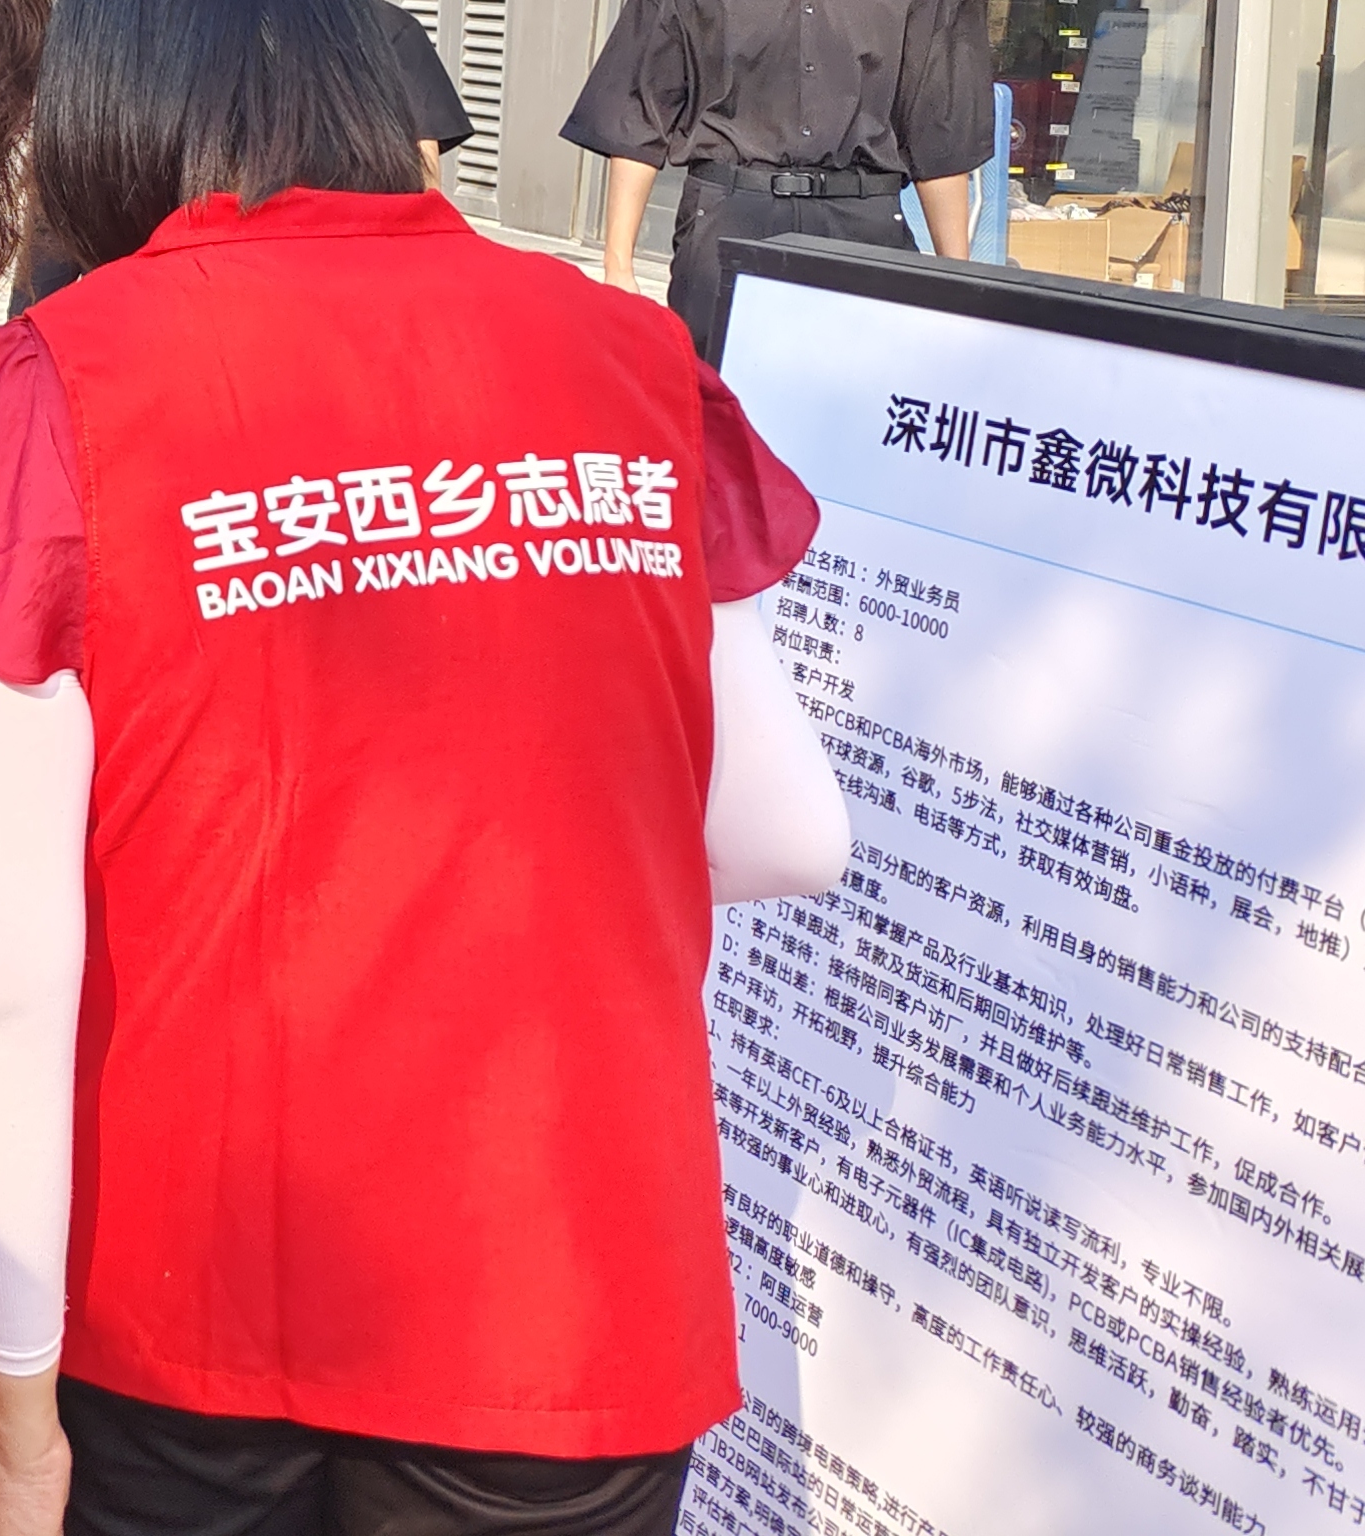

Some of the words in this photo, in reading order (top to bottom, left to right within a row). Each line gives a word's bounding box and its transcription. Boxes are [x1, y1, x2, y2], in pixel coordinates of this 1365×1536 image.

[181, 452, 679, 572] 宝安西乡志愿者
[882, 392, 1365, 560] 深圳市鑫微科技有限
[195, 560, 344, 620] BAOAN
[355, 543, 519, 593] XIXIANG
[523, 537, 683, 578] VOLUNTEER
[776, 596, 864, 642] 招聘人数：8
[772, 623, 842, 665] 岗位职责：
[712, 991, 780, 1041] 任职要求：
[717, 961, 977, 1114] 客户拜访，开拓视野，提升综合能力
[747, 897, 1092, 1070] 、订单跟进，货款及货运和后期回访维护等。
[799, 890, 1365, 1158] 动学习和掌握产品及行业基本知识，处理好日常销售工作，如客户
[709, 1047, 1365, 1445] 、一年以上外贸经验，熟悉外贸流程，具有独立开发客户的实操经验，熟练运用
[710, 1080, 1344, 1473] 英等开发新客户，有电子元器件（IC集成电路)，PCB或PCBA销售经验者优先。
[724, 1216, 817, 1291] 逻辑高度敏感
[743, 1292, 818, 1357] 7000-9000
[692, 1484, 759, 1536] 评估推广
[698, 1428, 853, 1536] 门B2B网站发布公司
[720, 1414, 901, 1536] 巴巴国际站的日常运营
